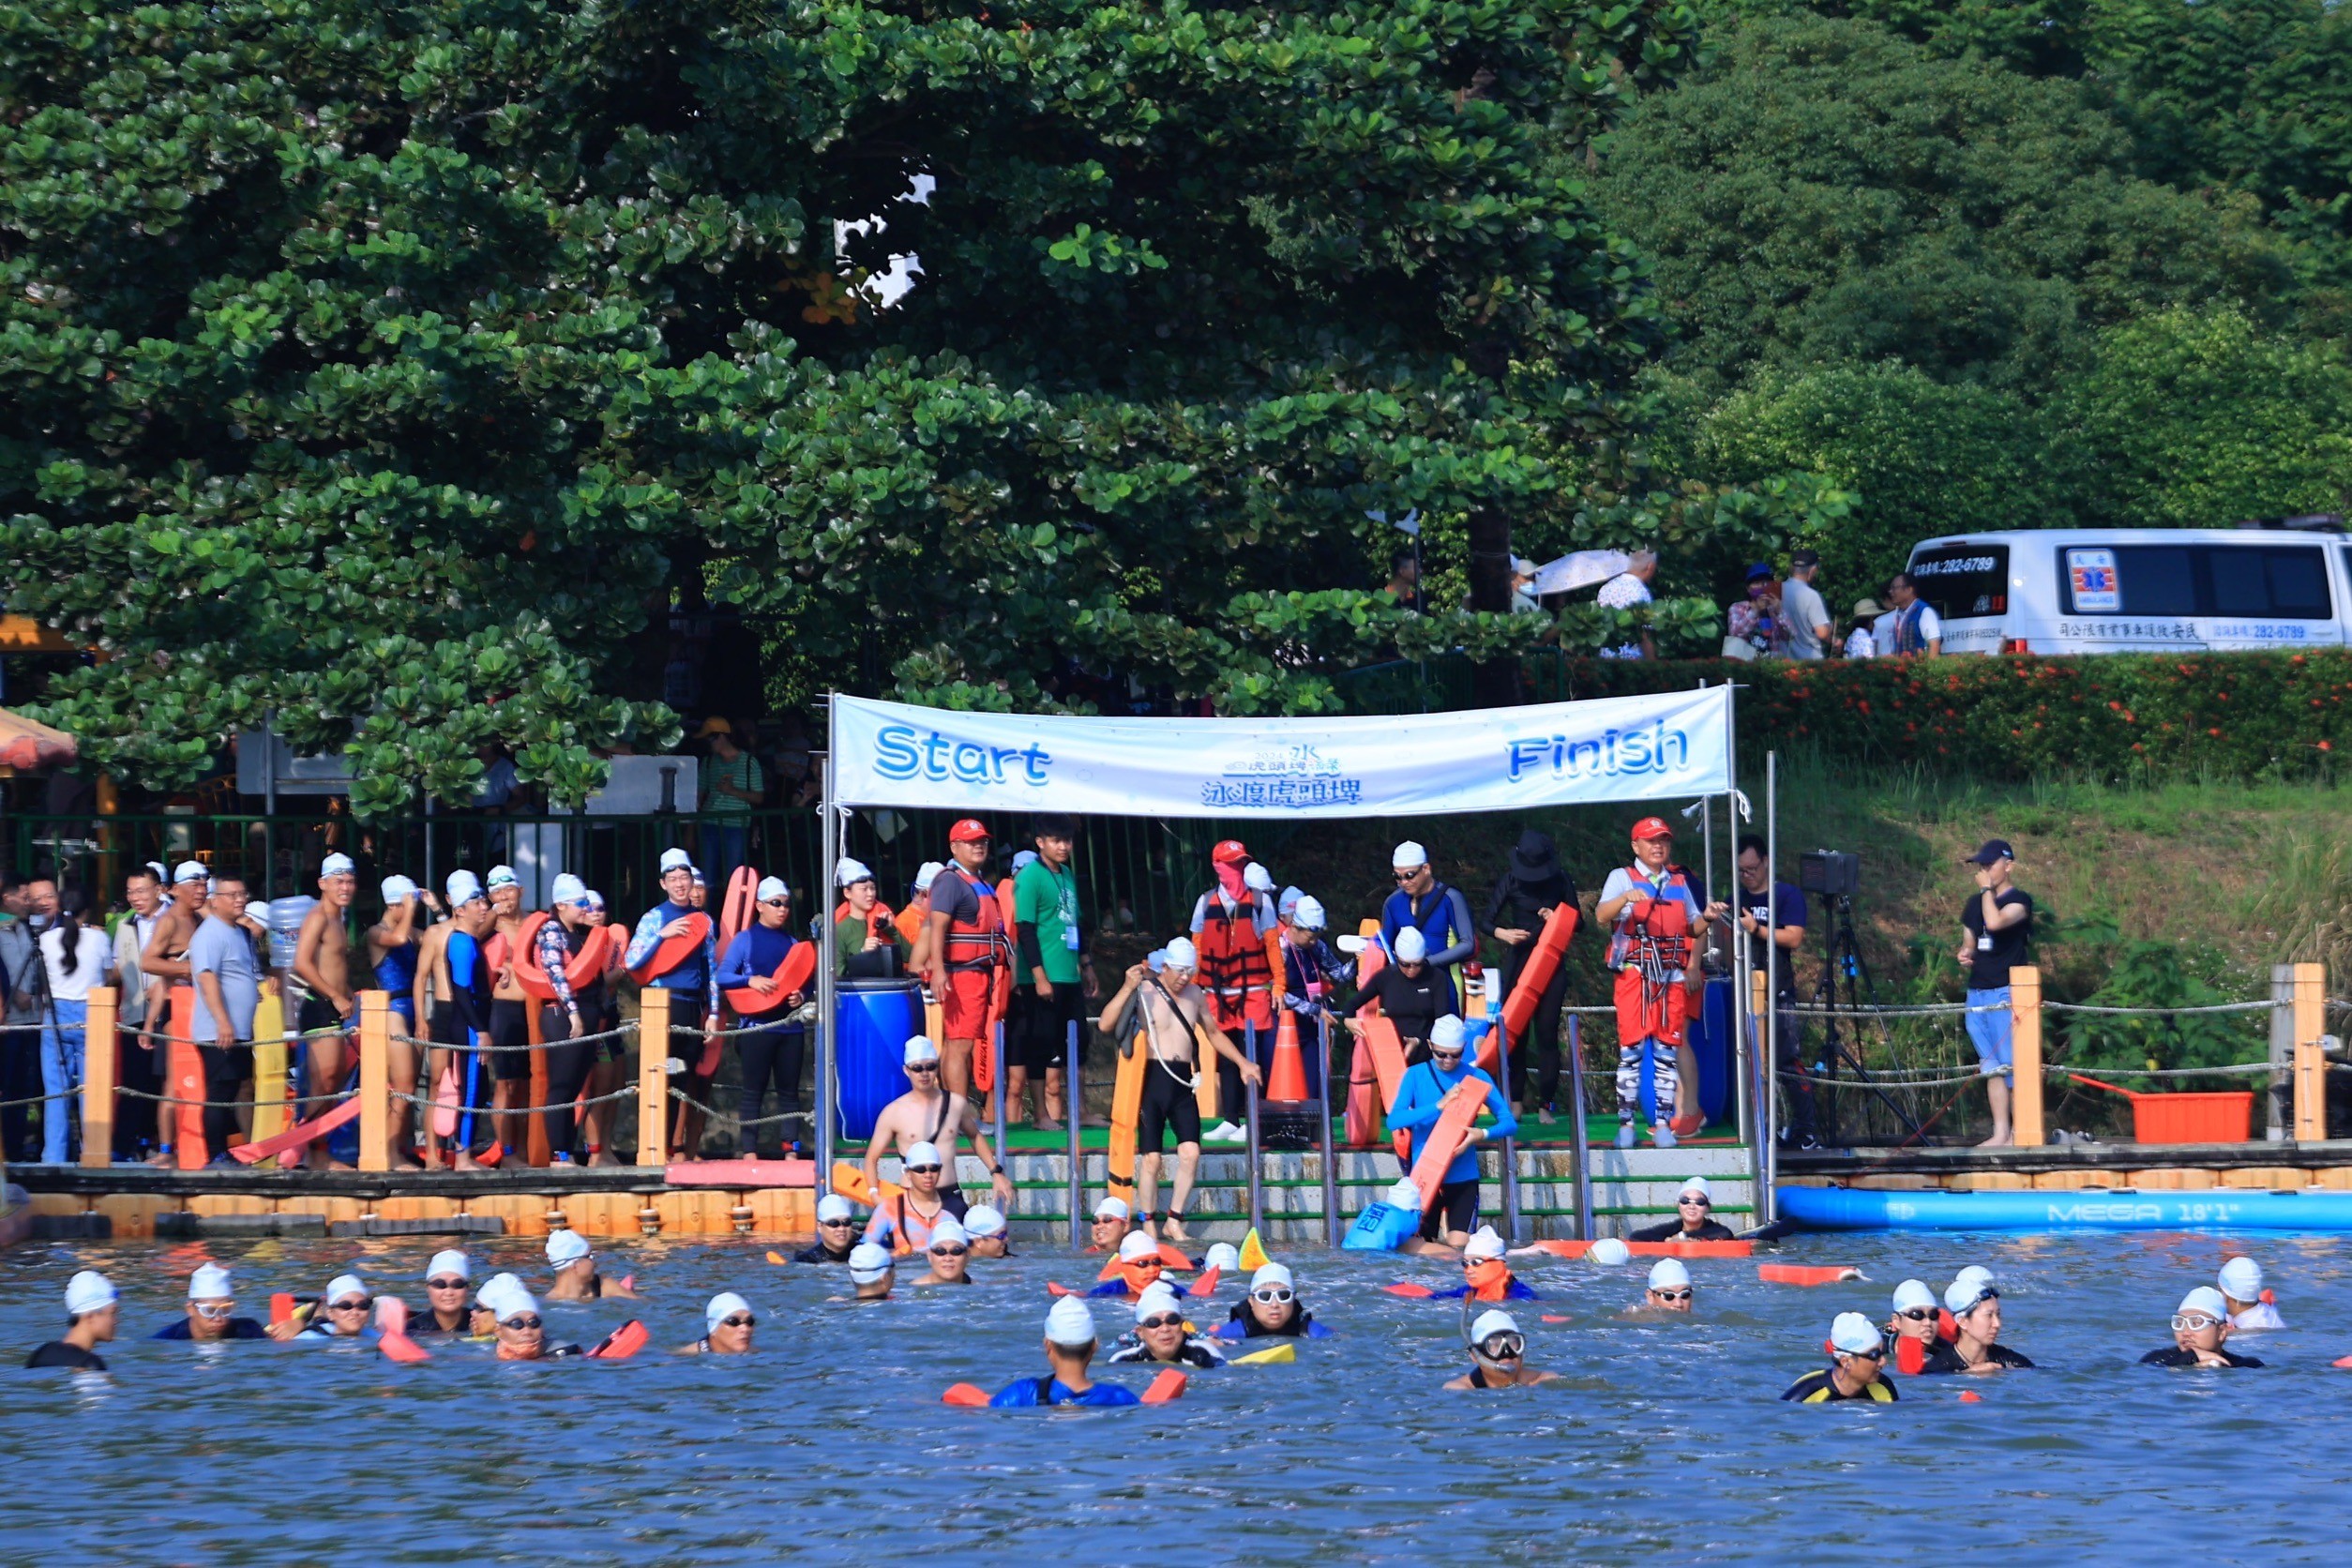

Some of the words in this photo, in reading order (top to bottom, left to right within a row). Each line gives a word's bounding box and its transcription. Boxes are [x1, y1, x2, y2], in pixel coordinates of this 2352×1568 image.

[874, 725, 1051, 784] Start
[1506, 718, 1688, 781] Finish
[1201, 778, 1363, 805] 泳渡虎頭埤
[1357, 1215, 1380, 1231] 20
[2048, 1204, 2162, 1221] MEGA
